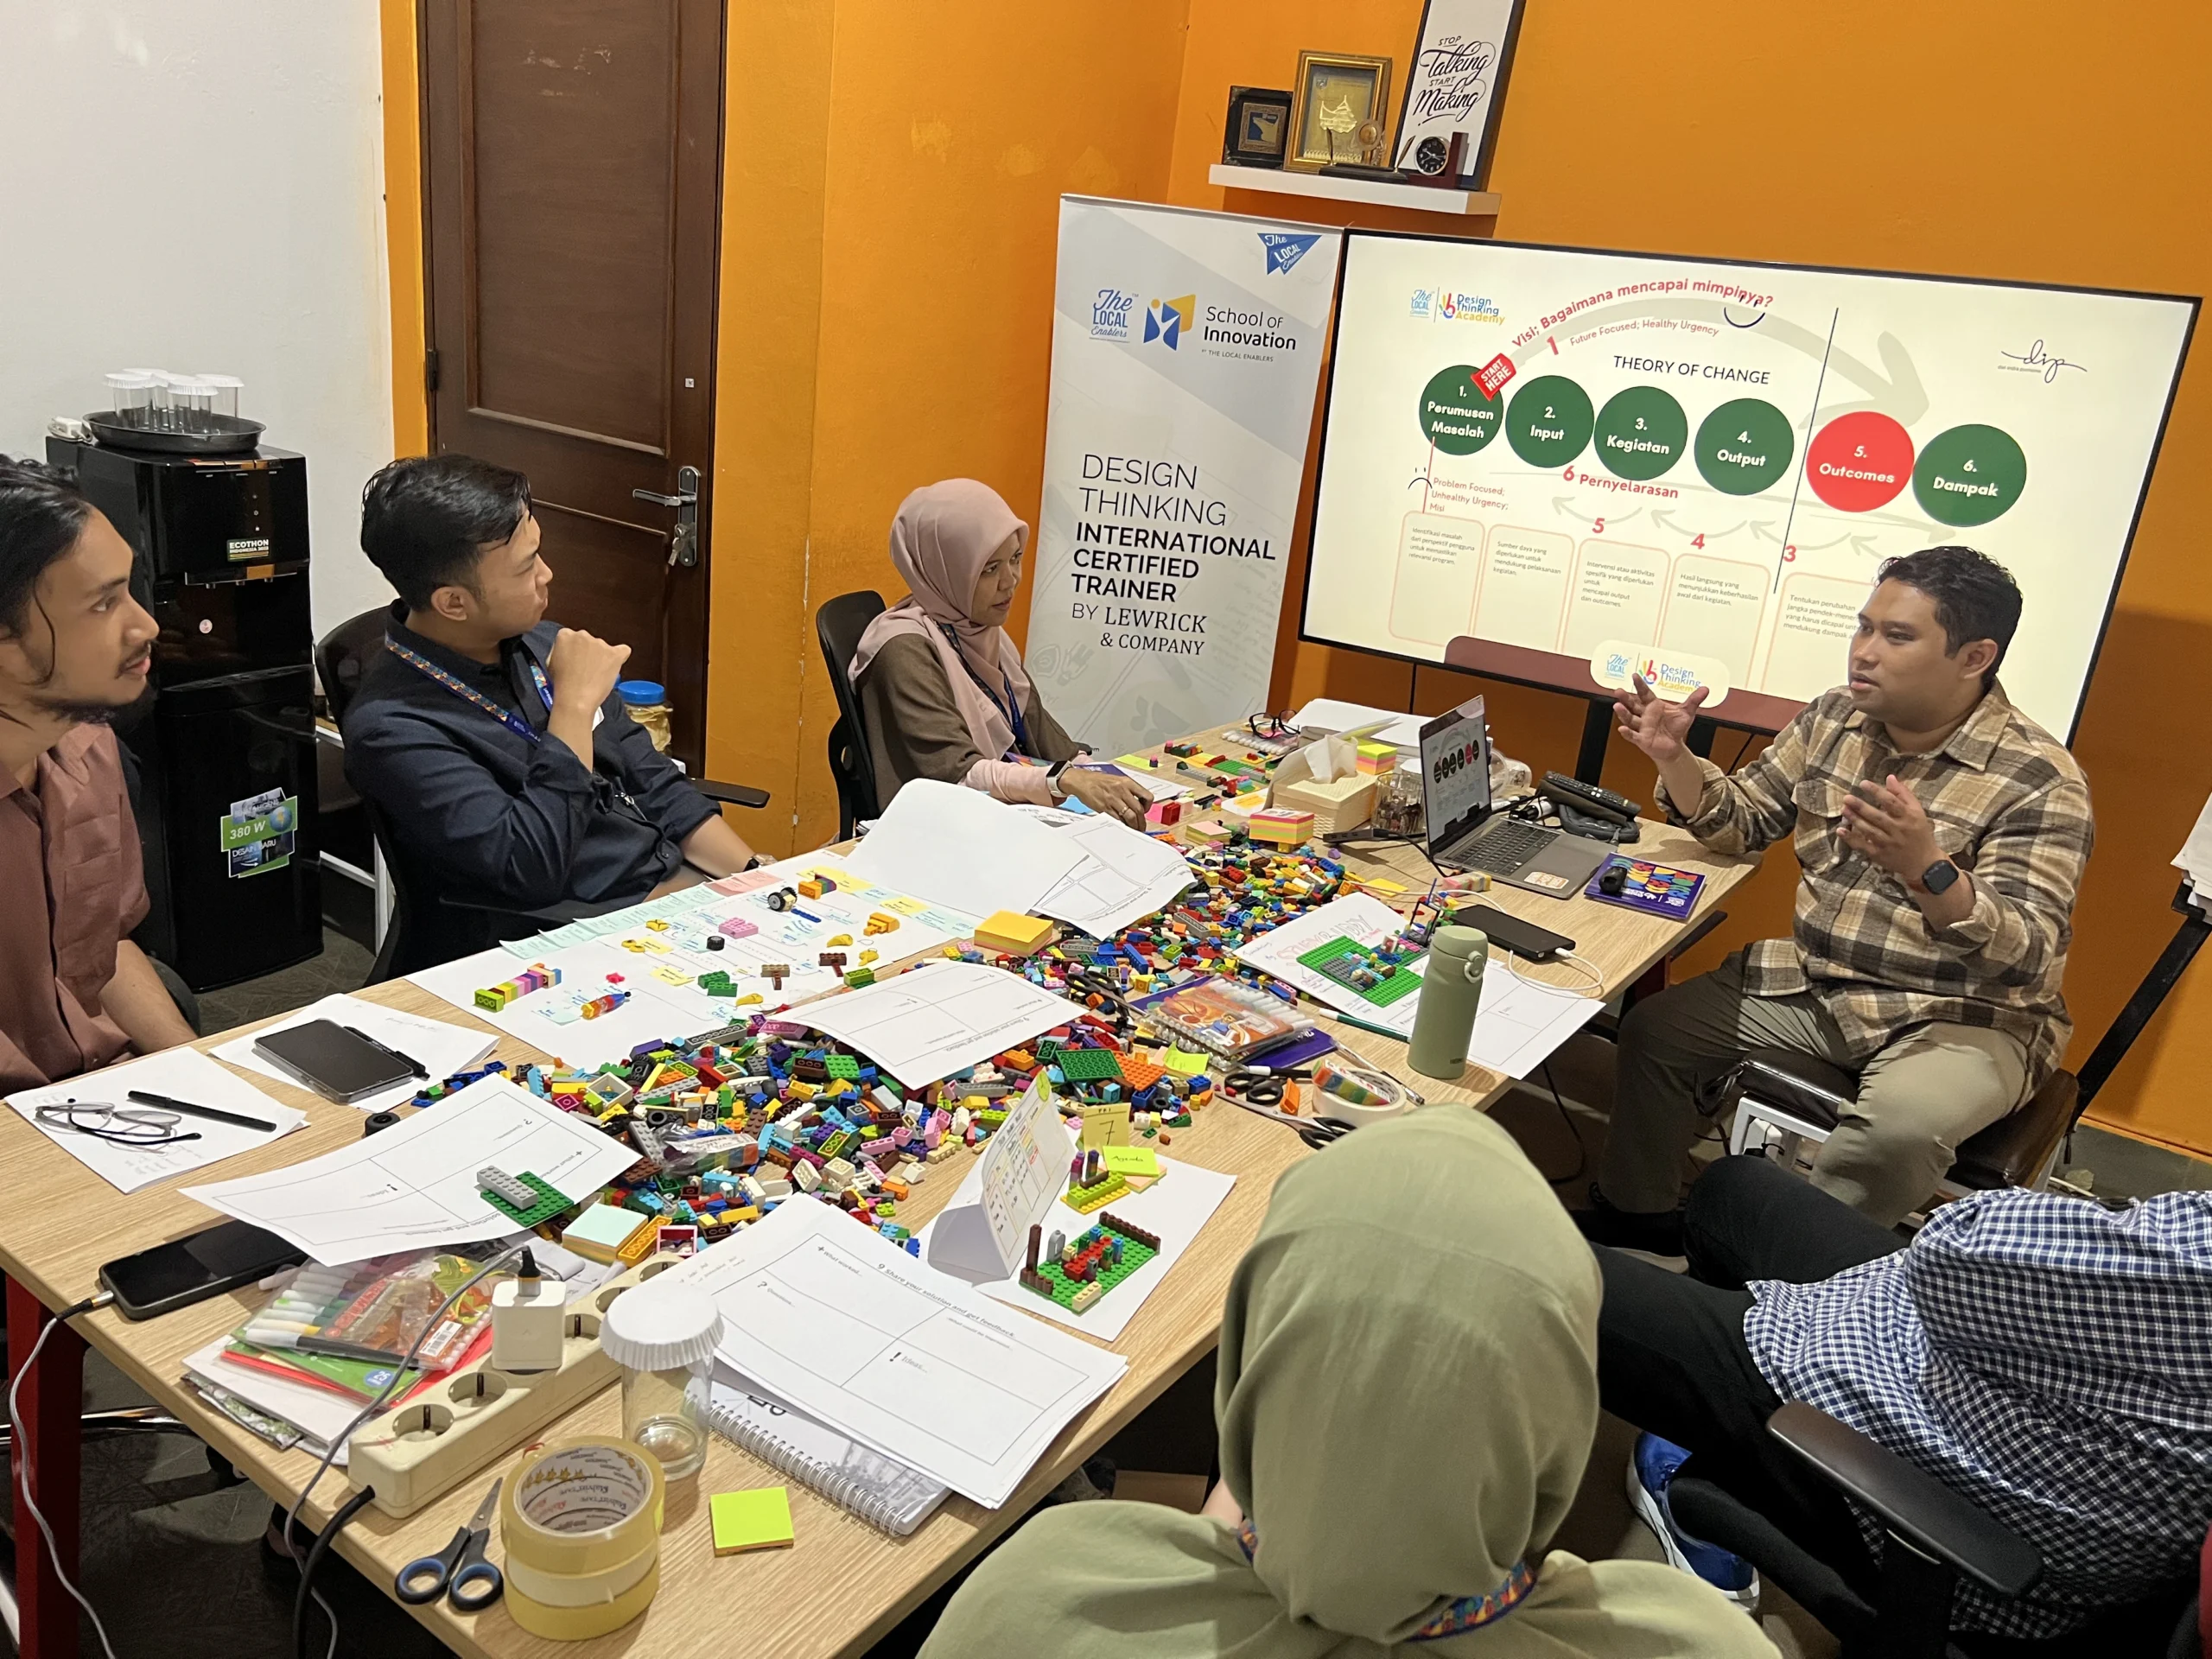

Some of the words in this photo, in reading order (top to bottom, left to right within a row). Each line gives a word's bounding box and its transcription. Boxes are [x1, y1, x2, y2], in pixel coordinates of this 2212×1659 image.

[1439, 36, 1462, 46] STOP
[1420, 41, 1496, 79] Talking
[1429, 77, 1456, 86] START
[1413, 79, 1486, 122] Making
[1265, 235, 1287, 246] The
[1274, 244, 1301, 263] LOCAL
[1093, 289, 1132, 311] The
[1412, 289, 1432, 302] The
[1458, 294, 1491, 306] Design
[1411, 299, 1429, 309] LOCAL
[1457, 302, 1499, 316] Thinking
[1093, 309, 1128, 327] LOCAL
[1206, 307, 1263, 327] School
[1268, 317, 1283, 328] of
[1455, 311, 1505, 326] Academy
[1512, 325, 1539, 347] Visi;
[1540, 291, 1613, 329] Bagaimana
[1618, 278, 1688, 297] mencapai
[1693, 280, 1773, 308] mimpinya?
[1091, 326, 1127, 337] Enablers
[1205, 326, 1296, 350] Innovation
[1570, 330, 1597, 346] Future
[1599, 321, 1640, 336] Focused;
[1643, 320, 1678, 329] Healthy
[1681, 321, 1719, 337] Urgency
[1547, 336, 1559, 355] 1
[1480, 359, 1503, 382] START
[1613, 355, 1675, 373] THEORY
[1678, 363, 1699, 376] OF
[1703, 366, 1770, 385] CHANGE
[1484, 366, 1511, 391] HERE
[1459, 386, 1467, 397] 1.
[1427, 401, 1494, 420] Perumusan
[1544, 407, 1555, 418] 2.
[1431, 422, 1484, 438] Masalah
[1635, 418, 1648, 430] 3.
[1530, 425, 1564, 441] Input
[1738, 431, 1751, 443] 4.
[1606, 435, 1669, 456] Kegiatan
[1854, 446, 1867, 458] 5.
[1717, 450, 1766, 468] Output
[1963, 460, 1977, 473] 6.
[1083, 454, 1197, 489] DESIGN
[1819, 464, 1894, 483] Outcomes
[1433, 478, 1467, 490] Problem
[1470, 483, 1505, 496] Focused;
[1562, 465, 1575, 482] 6
[1580, 474, 1679, 499] Pernyelarasan
[1932, 477, 1999, 498] Dampak
[1079, 487, 1226, 525] THINKING
[1430, 503, 1445, 512] Misi
[1432, 490, 1470, 504] Unhealthy
[1472, 497, 1509, 510] Urgency;
[1413, 527, 1440, 537] Identifikasi
[1592, 518, 1605, 534] 5
[230, 539, 269, 549] ECOTHON
[1076, 522, 1275, 560] INTERNATIONAL
[1422, 537, 1448, 548] perspektif
[1497, 541, 1518, 550] Sumber
[1519, 545, 1532, 554] daya
[1690, 533, 1705, 550] 4
[1408, 553, 1432, 562] relevansi
[1497, 550, 1524, 561] diperlukan
[1783, 545, 1796, 562] 3
[1073, 549, 1198, 578] CERTIFIED
[1495, 559, 1526, 569] mendukung
[1528, 563, 1561, 574] pelaksanaan
[1587, 561, 1615, 571] Intervensi
[1630, 568, 1655, 577] aktivitas
[1586, 570, 1606, 580] spesifik
[1624, 576, 1654, 587] diperlukan
[1697, 576, 1723, 587] langsung
[1071, 574, 1176, 602] TRAINER
[1582, 588, 1610, 597] mencapai
[1679, 583, 1719, 594] menunjukkan
[1720, 589, 1758, 601] keberhasilan
[1787, 603, 1808, 613] jangka
[1790, 594, 1820, 605] Tentukan
[1821, 601, 1856, 611] perubahan
[1072, 603, 1098, 620] BY
[1105, 607, 1207, 632] LEWRICK
[1785, 613, 1801, 622] yang
[1802, 616, 1820, 625] harus
[1821, 619, 1844, 629] dicapai
[1783, 622, 1821, 635] mendukung
[1822, 628, 1847, 639] dampak
[1101, 633, 1113, 647] &
[1119, 634, 1205, 655] COMPANY
[1607, 654, 1629, 667] The
[1607, 661, 1625, 674] LOCAL
[1660, 664, 1694, 677] Design
[1657, 679, 1696, 692] Academ
[1660, 671, 1701, 688] Thinking
[230, 826, 251, 840] 380
[254, 821, 265, 833] W
[1099, 1120, 1115, 1145] 7
[468, 1212, 501, 1226] solution
[823, 1251, 837, 1262] What
[885, 1269, 905, 1283] Share
[906, 1281, 923, 1292] your
[923, 1290, 951, 1306] solution
[951, 1305, 967, 1314] and
[966, 1313, 980, 1322] get
[373, 1371, 390, 1381] 25
